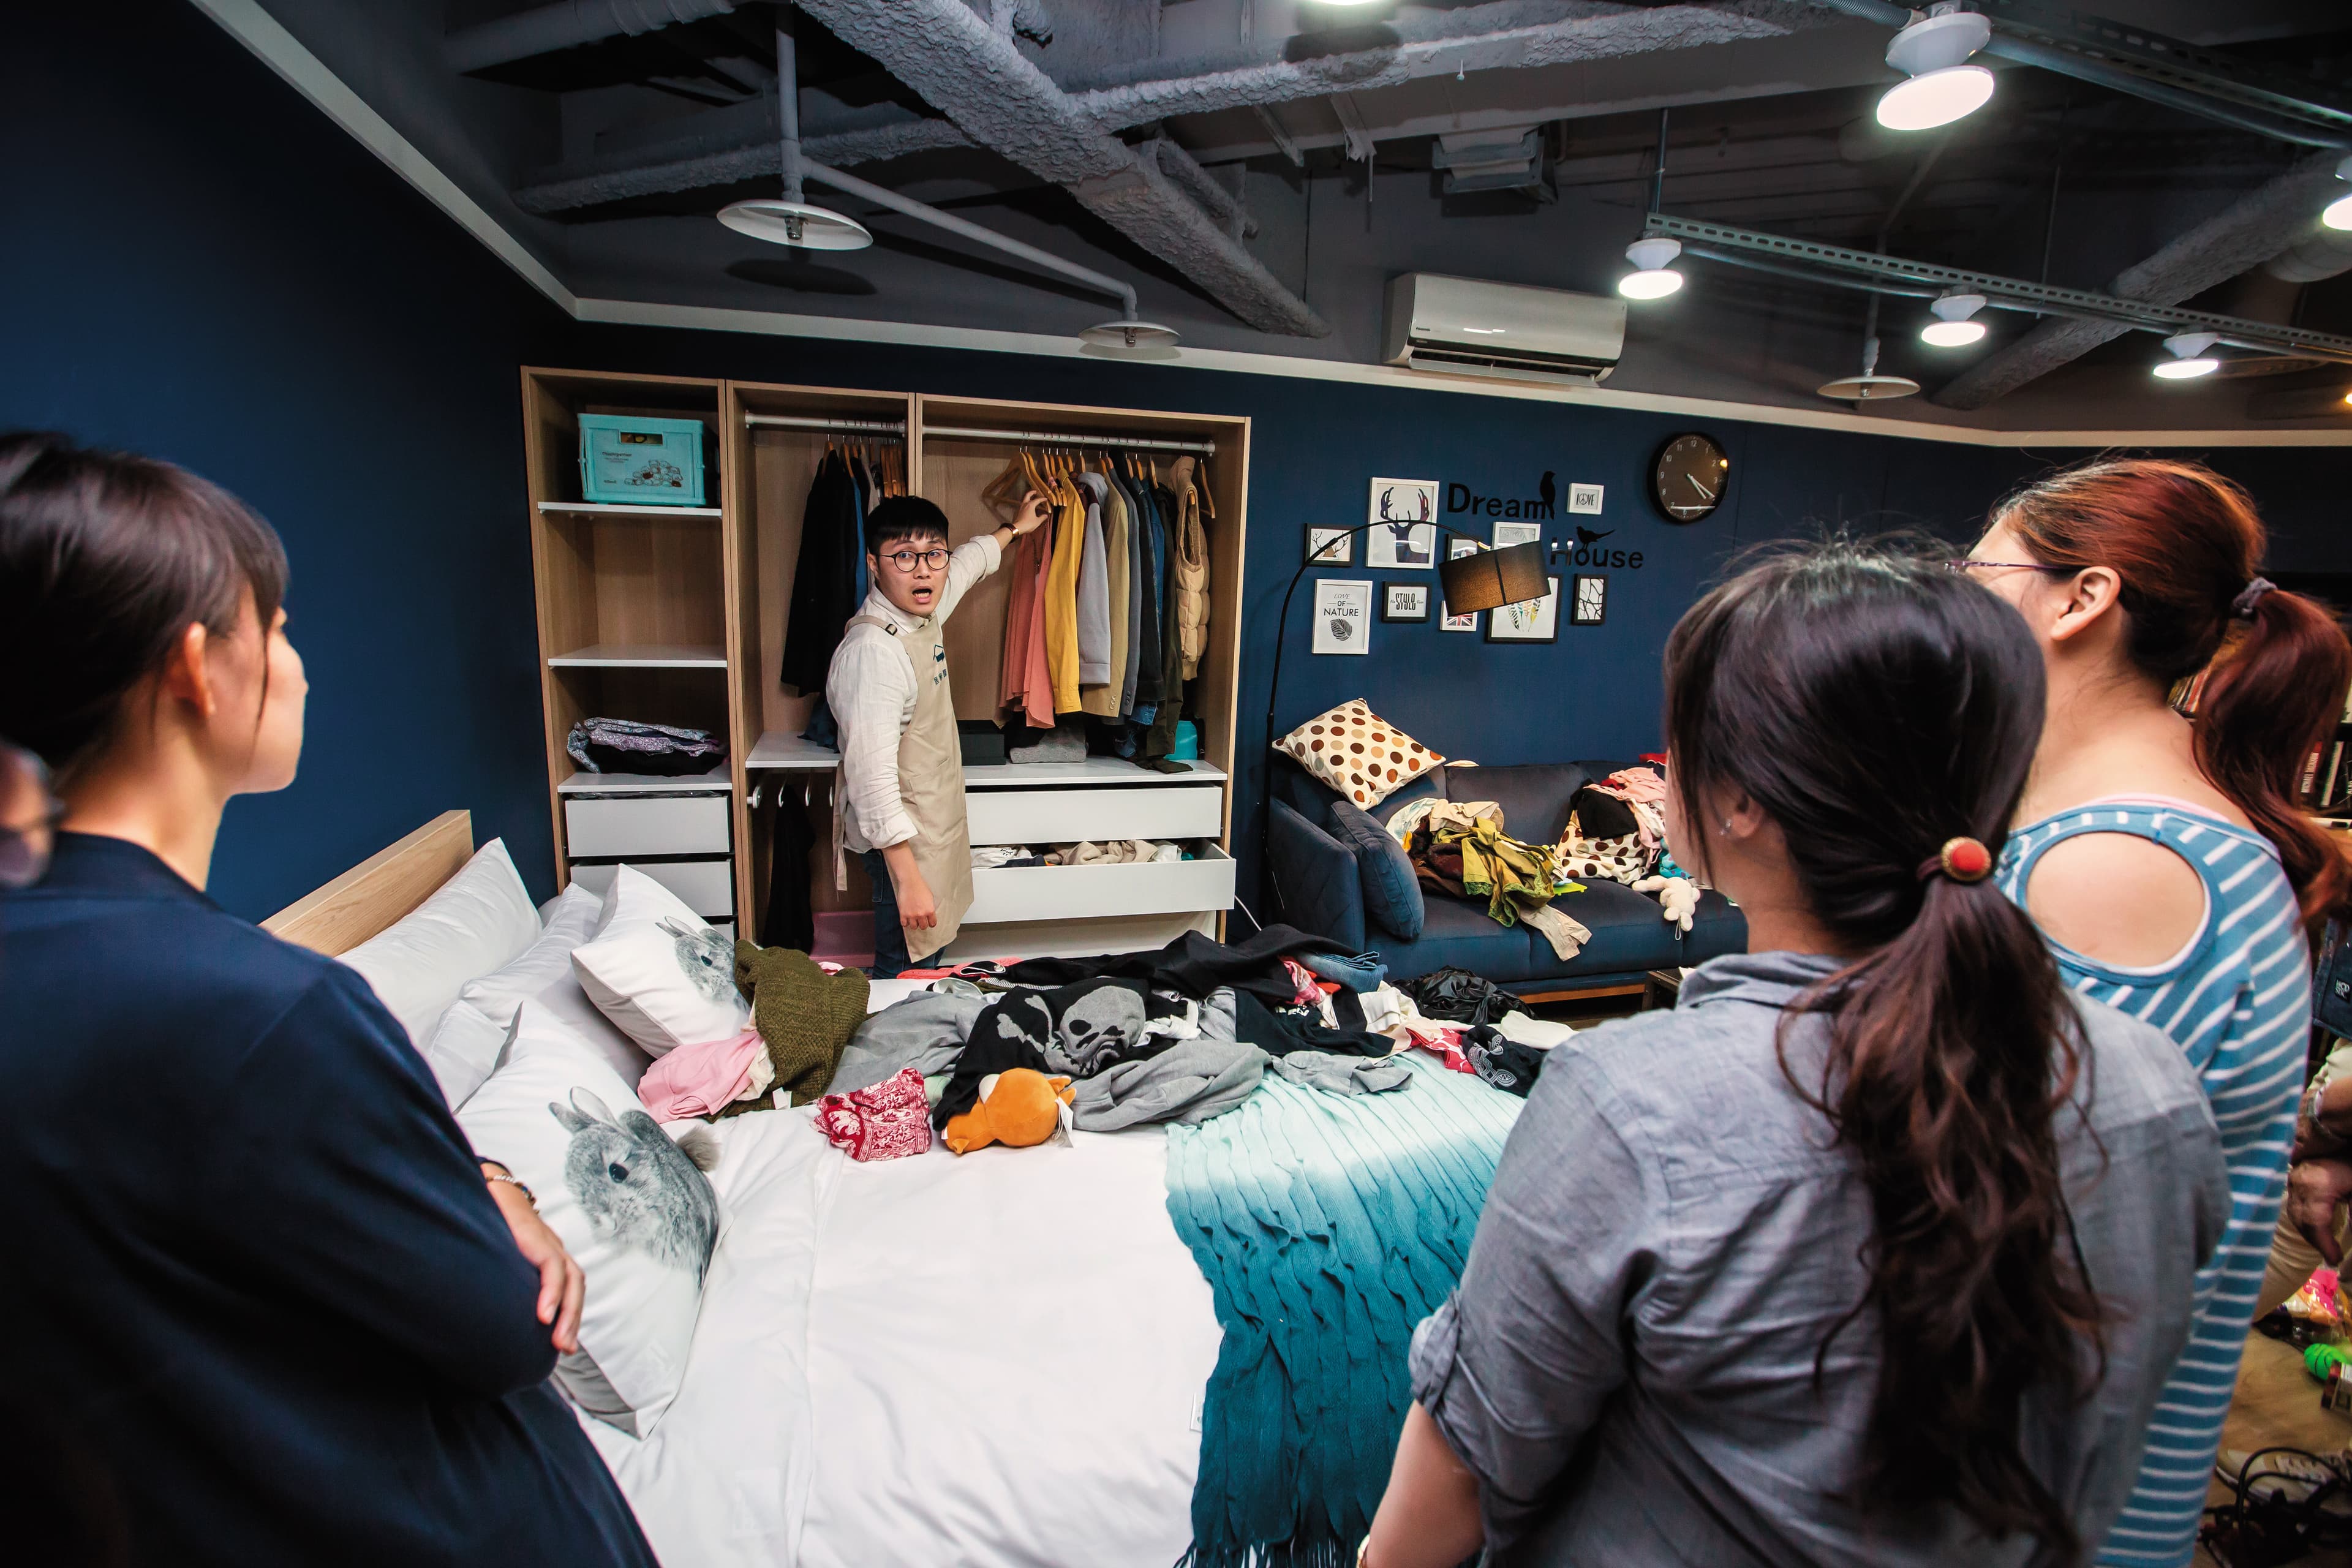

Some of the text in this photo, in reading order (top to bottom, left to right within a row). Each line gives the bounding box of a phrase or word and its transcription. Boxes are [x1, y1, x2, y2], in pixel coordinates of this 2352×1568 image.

[1447, 483, 1546, 519] Dream
[1550, 537, 1643, 569] House
[1324, 608, 1359, 617] NATURE
